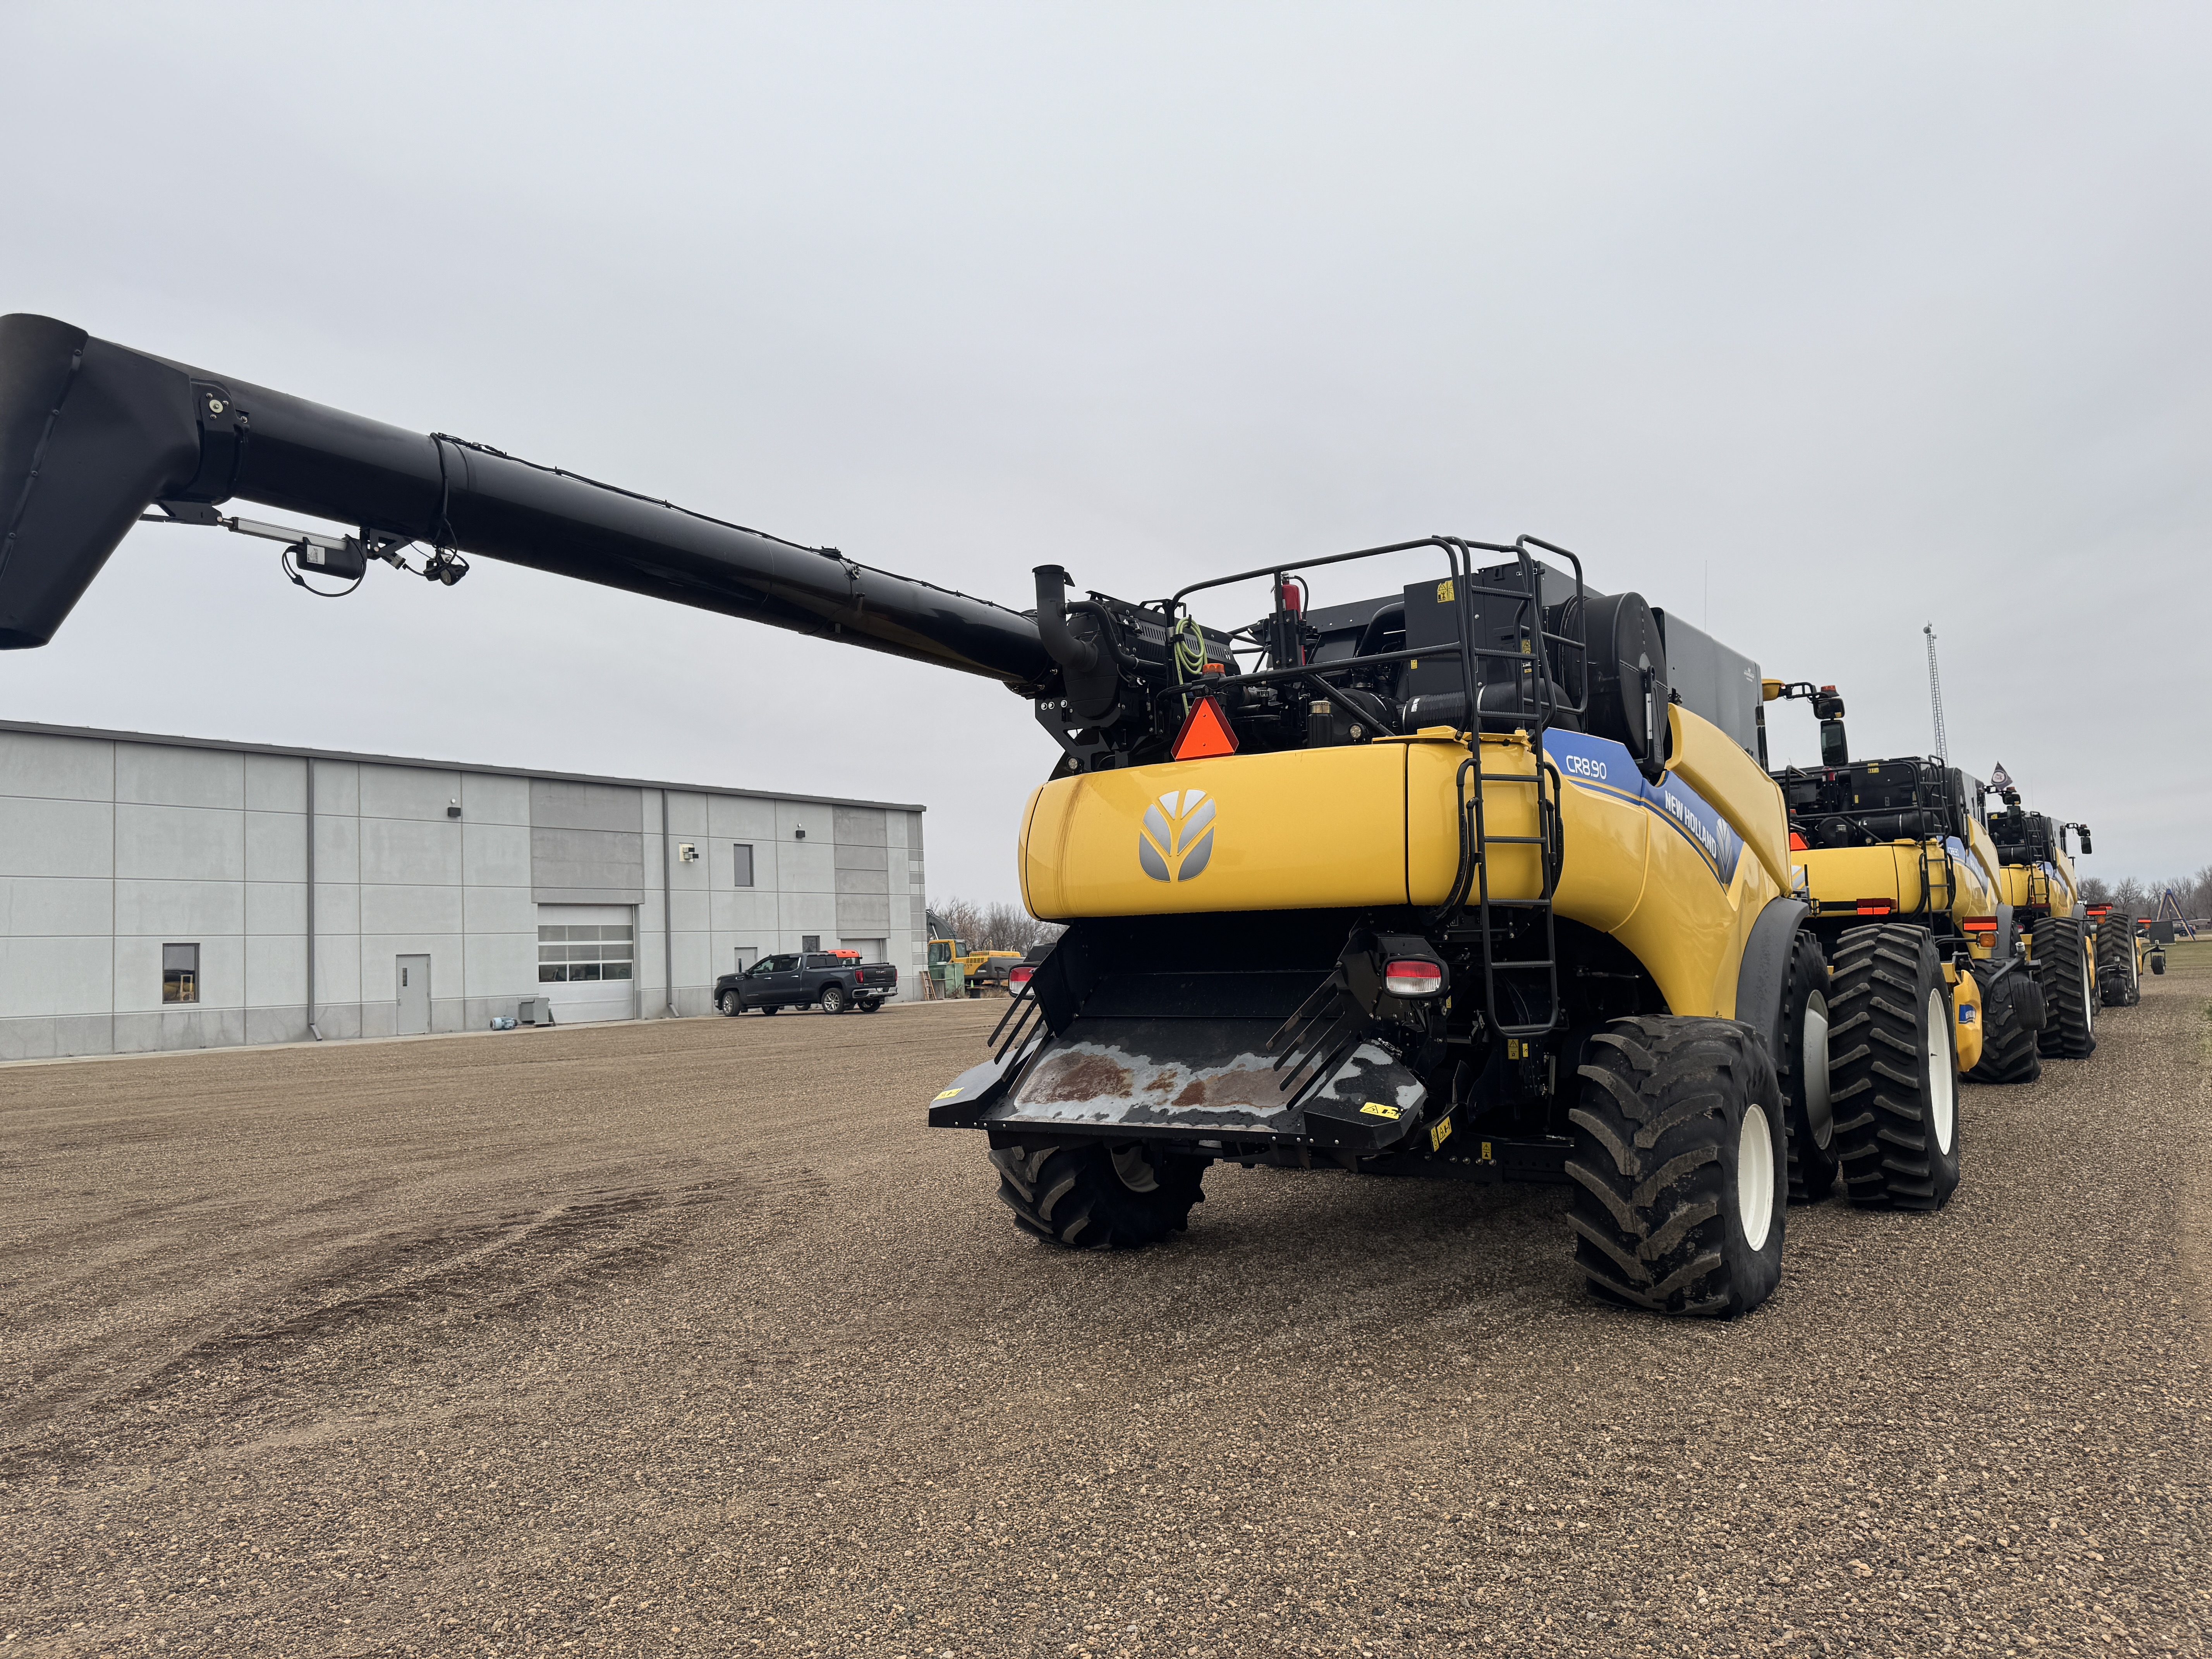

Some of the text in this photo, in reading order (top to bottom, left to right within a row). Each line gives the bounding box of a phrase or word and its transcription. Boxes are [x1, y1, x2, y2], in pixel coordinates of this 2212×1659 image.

[1566, 755, 1607, 780] CR8.90
[1665, 790, 1716, 859] NEW HOLLAND
